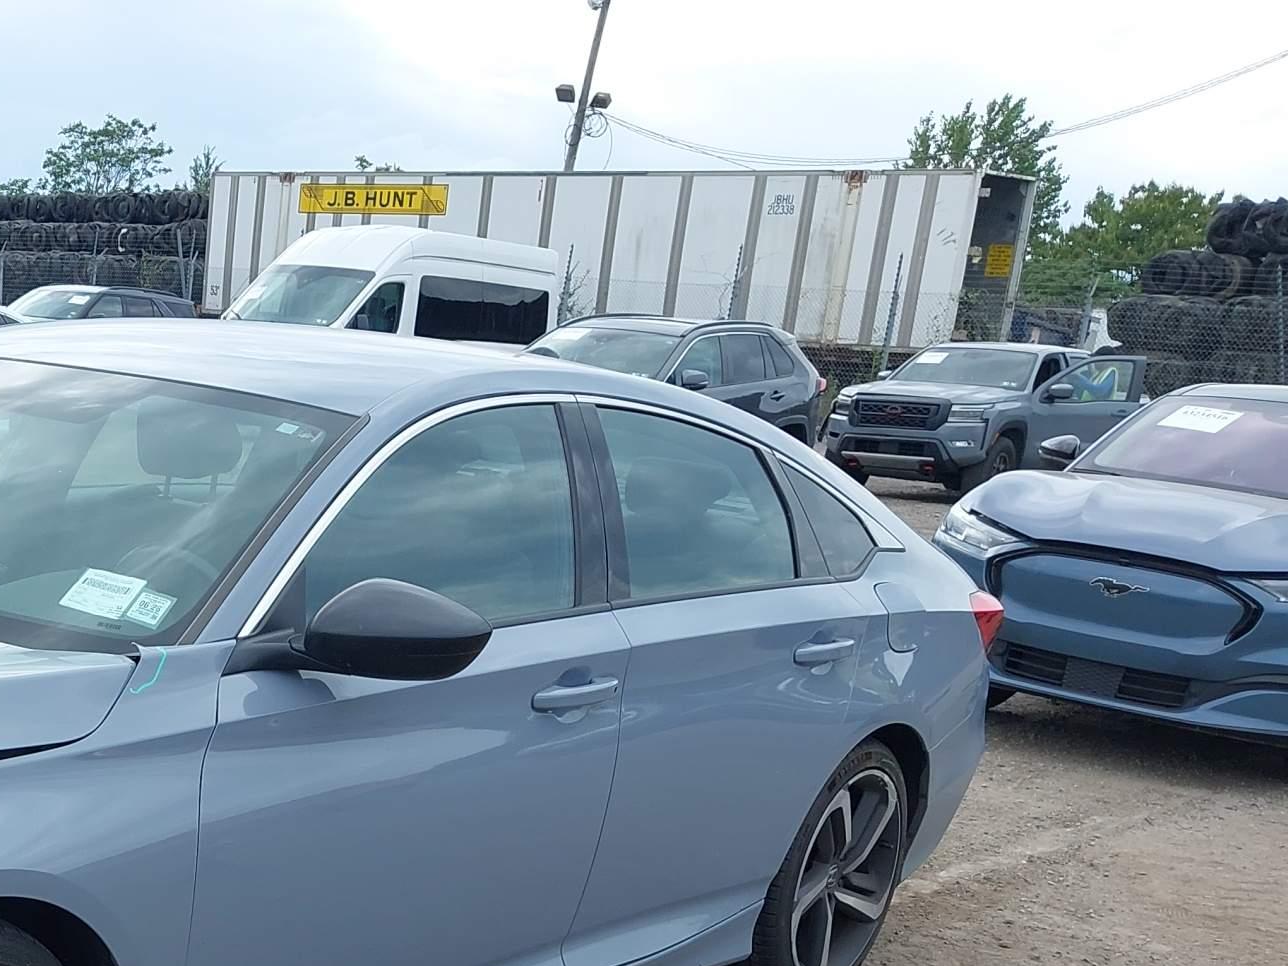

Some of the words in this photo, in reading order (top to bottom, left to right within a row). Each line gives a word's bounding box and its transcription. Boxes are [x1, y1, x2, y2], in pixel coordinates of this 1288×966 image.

[327, 191, 360, 207] J.B.
[365, 191, 417, 208] HUNT
[772, 194, 794, 205] JBHU
[767, 204, 795, 215] 212338
